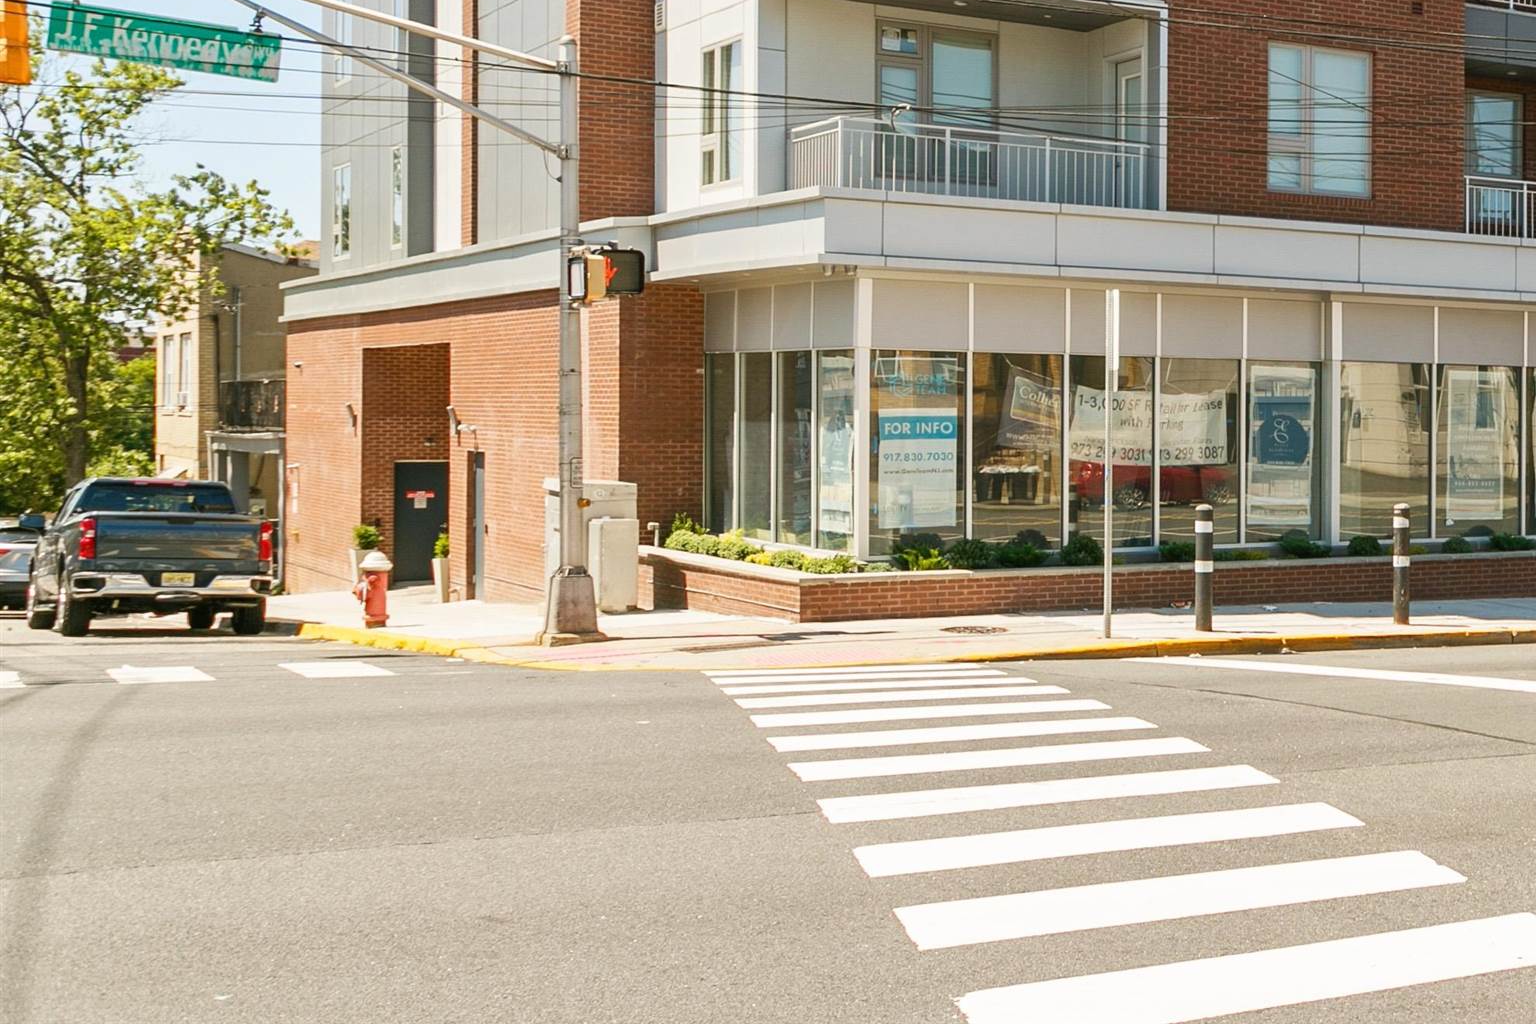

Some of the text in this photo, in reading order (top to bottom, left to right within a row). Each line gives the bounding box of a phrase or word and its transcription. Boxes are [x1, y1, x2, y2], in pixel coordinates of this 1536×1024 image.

[112, 15, 239, 64] Kennedy
[884, 421, 953, 436] FOR INFO
[883, 452, 954, 463] 917.830.7030
[1198, 446, 1225, 460] 3087
